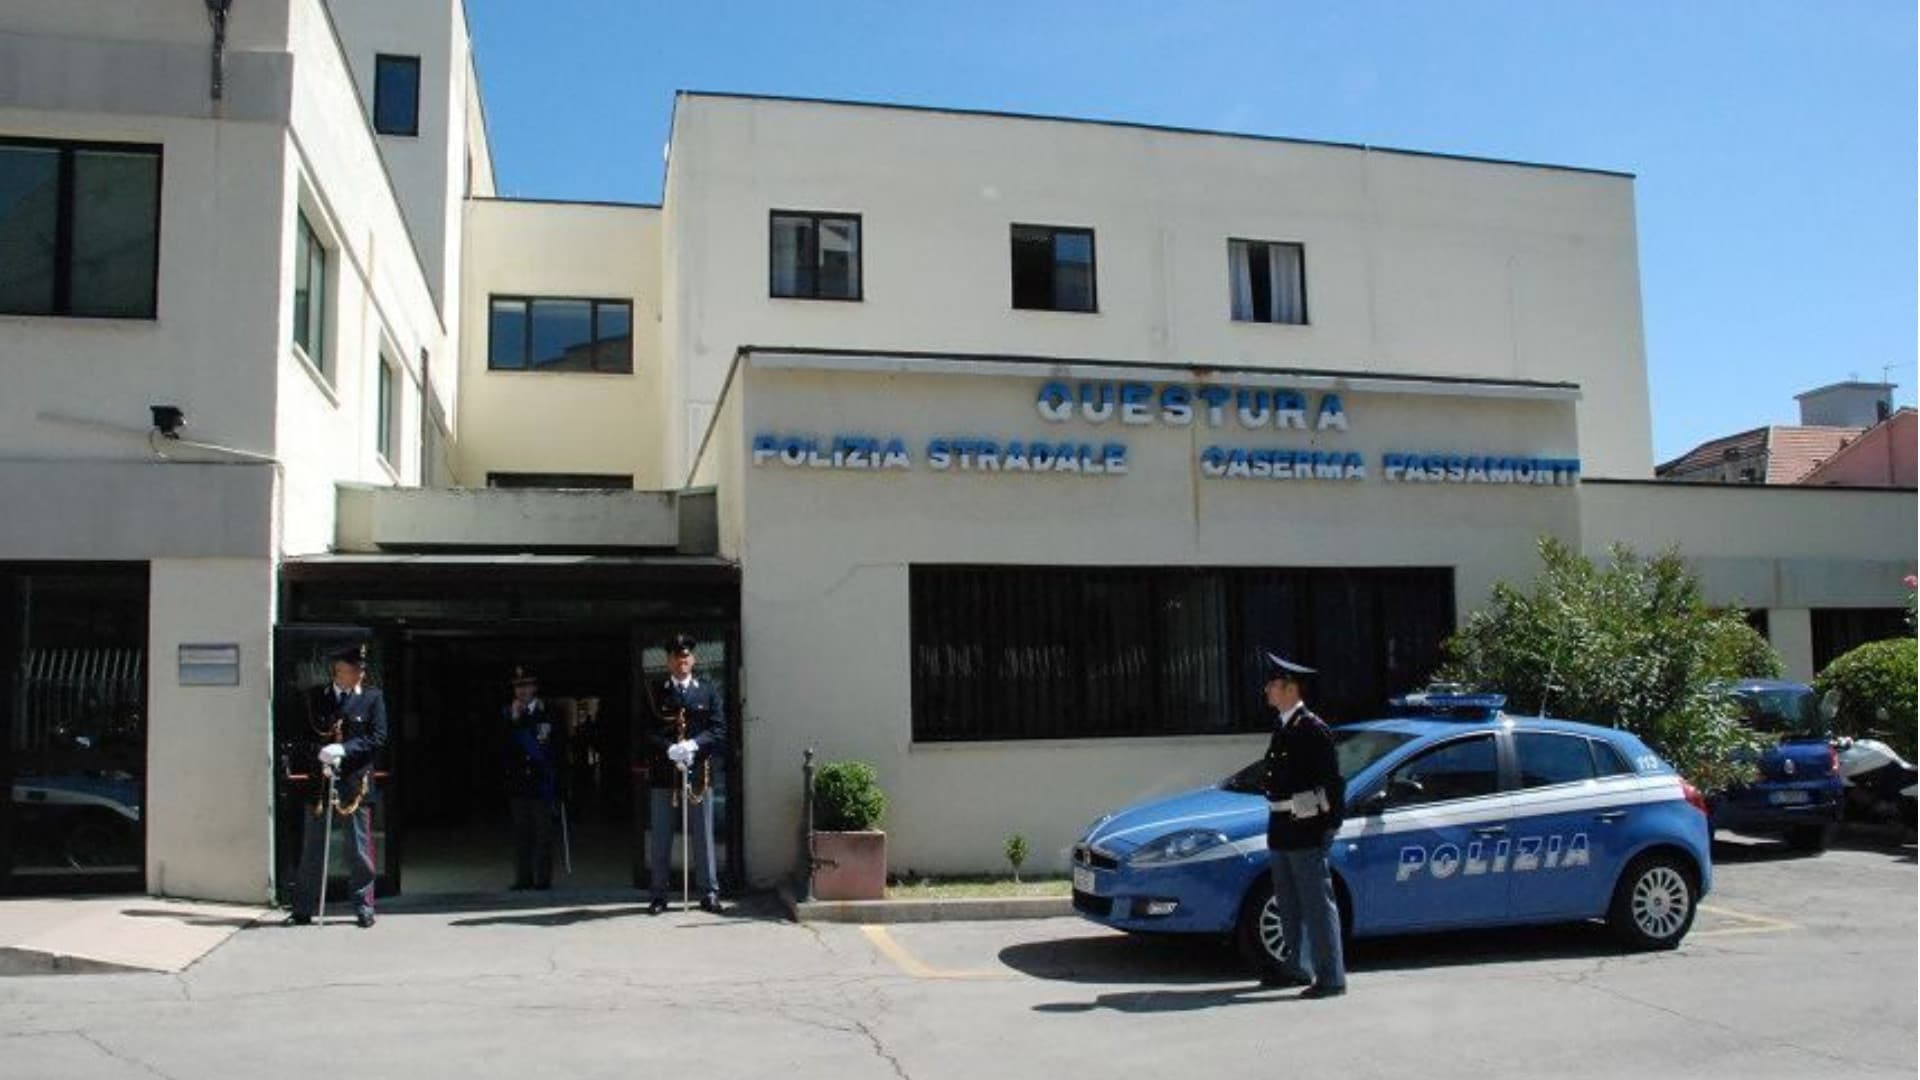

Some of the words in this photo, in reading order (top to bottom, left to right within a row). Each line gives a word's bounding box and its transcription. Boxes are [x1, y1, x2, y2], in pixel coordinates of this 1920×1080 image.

[1037, 380, 1349, 432] QUESTURA
[753, 433, 910, 468] POLIZIA
[927, 436, 1128, 474] STRADALE
[1201, 445, 1366, 480] CASERMA
[1382, 452, 1581, 486] PASSAMONTI
[1396, 832, 1591, 882] POLIZIA
